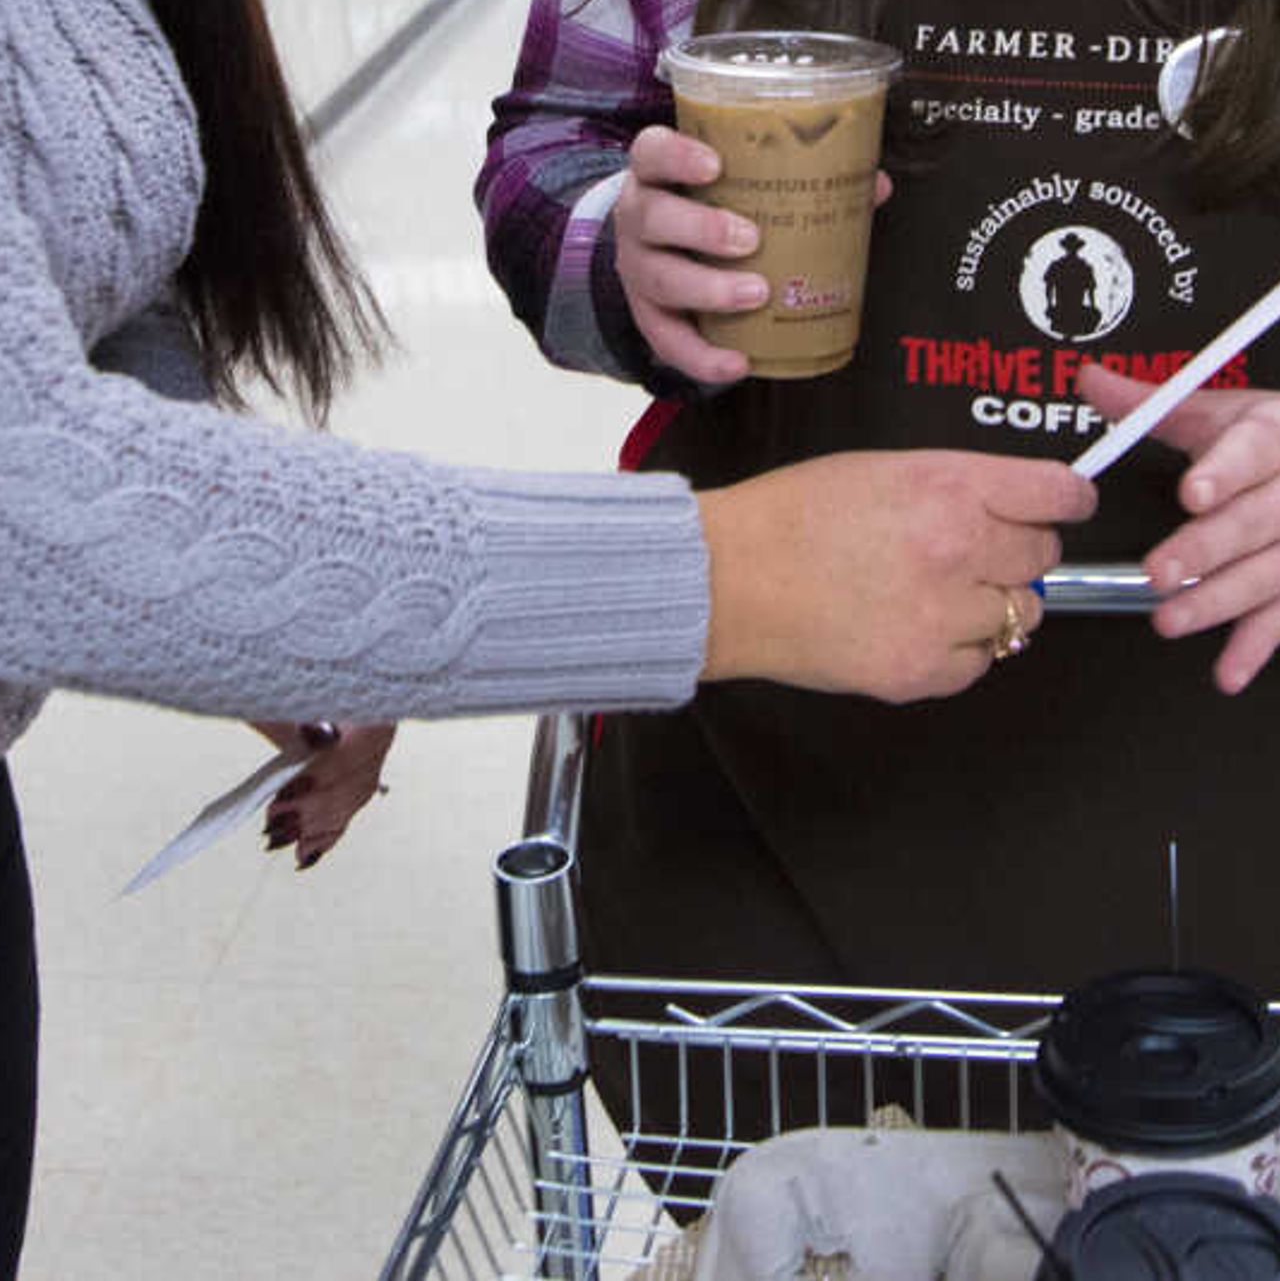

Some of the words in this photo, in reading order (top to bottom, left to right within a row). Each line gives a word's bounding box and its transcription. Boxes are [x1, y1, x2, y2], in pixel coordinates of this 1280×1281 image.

[915, 24, 1076, 60] FARMER
[1075, 105, 1160, 134] grade
[956, 173, 1081, 292] sustainably
[1088, 181, 1191, 264] sourced
[1169, 267, 1199, 304] by
[1052, 348, 1250, 397] FRMS
[970, 395, 1104, 433] COFF
